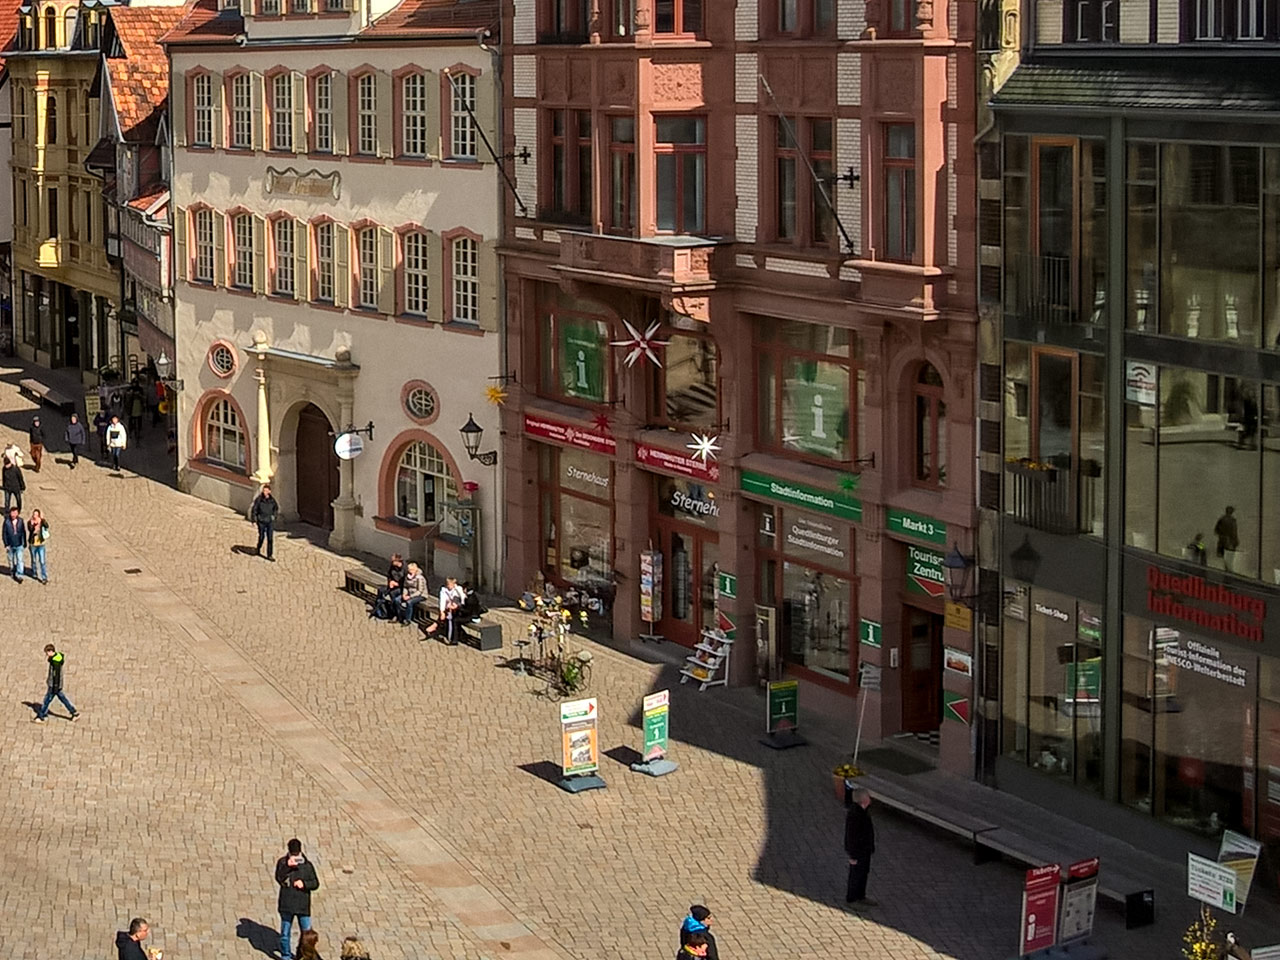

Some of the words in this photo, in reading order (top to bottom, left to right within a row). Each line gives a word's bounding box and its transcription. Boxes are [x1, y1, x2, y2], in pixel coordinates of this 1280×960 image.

[567, 465, 609, 487] Sternehaus
[770, 482, 834, 509] Stadtinformation
[792, 525, 839, 545] Quedlinburger
[902, 517, 927, 534] Markt
[927, 524, 934, 536] 3
[787, 534, 844, 558] Stadtinformation
[1147, 564, 1266, 624] Quedlinburg
[1147, 589, 1264, 643] Information
[1186, 640, 1220, 659] Offizielle
[1232, 665, 1247, 677] der
